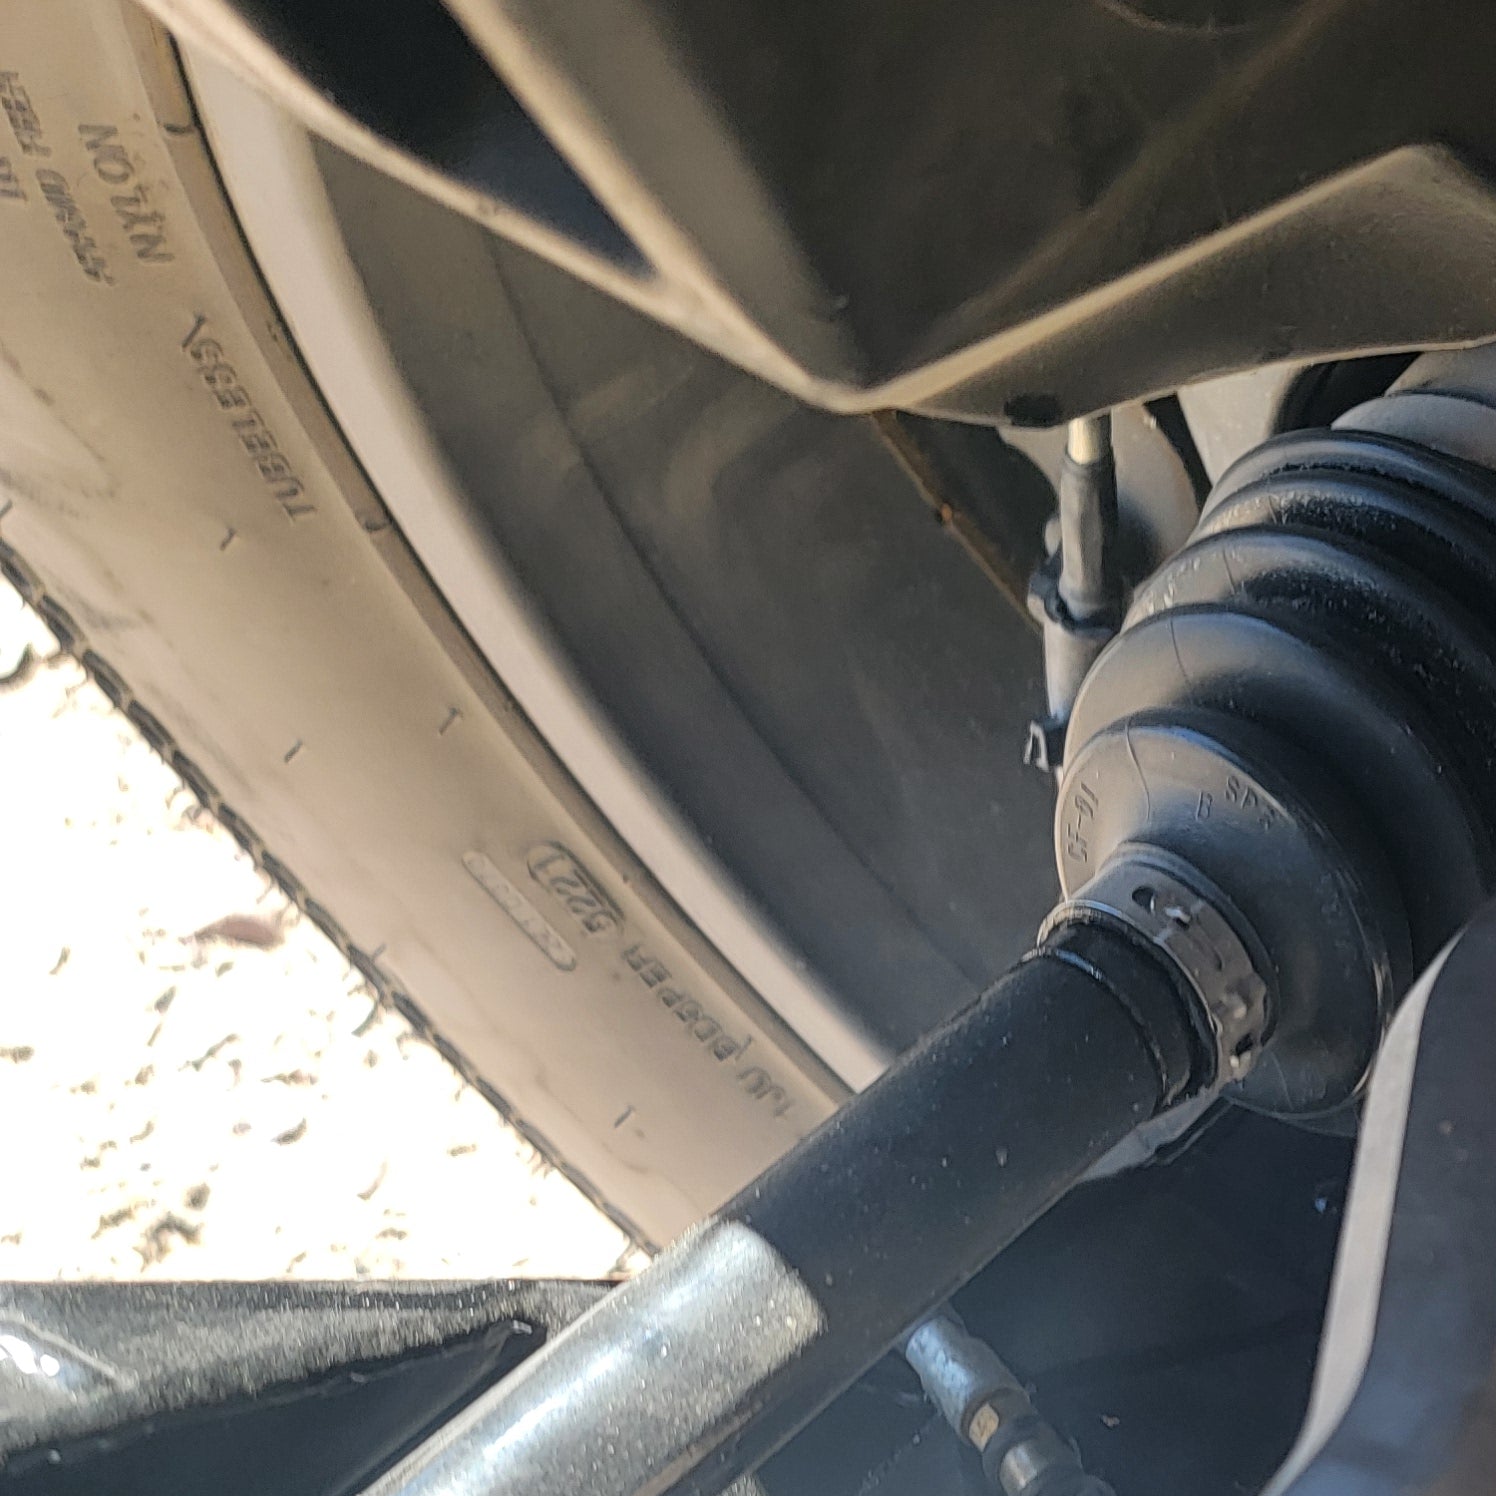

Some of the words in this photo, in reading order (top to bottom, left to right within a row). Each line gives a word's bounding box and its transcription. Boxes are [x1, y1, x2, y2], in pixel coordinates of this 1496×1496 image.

[78, 123, 176, 263] NYLON
[190, 337, 319, 524] TUBELESS
[530, 846, 618, 935] 5221
